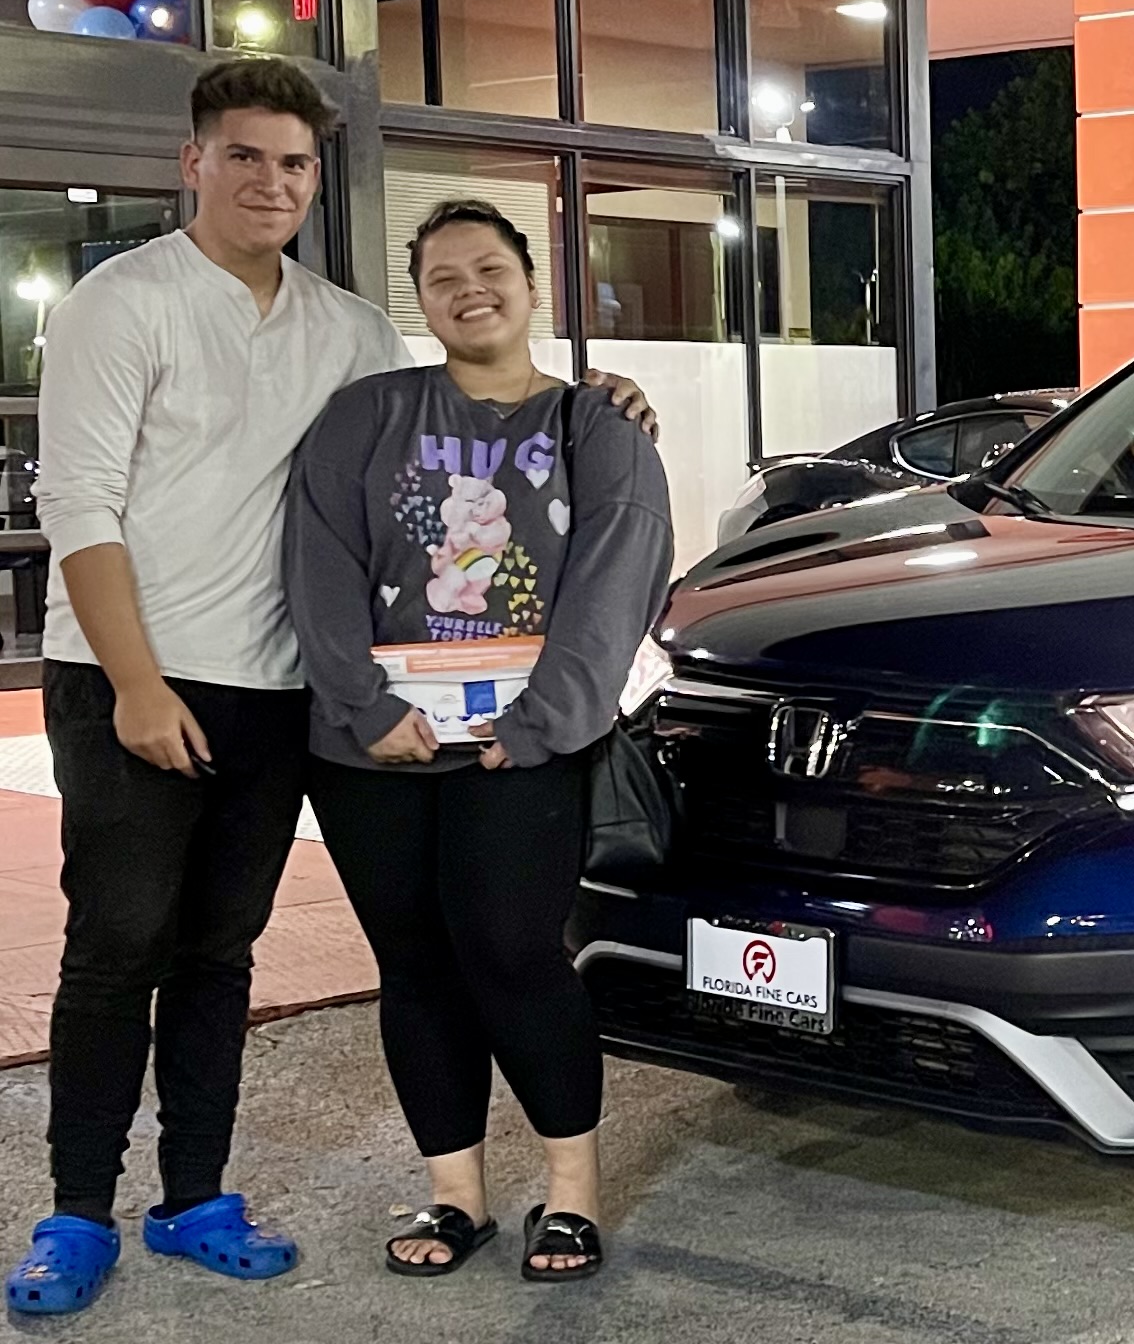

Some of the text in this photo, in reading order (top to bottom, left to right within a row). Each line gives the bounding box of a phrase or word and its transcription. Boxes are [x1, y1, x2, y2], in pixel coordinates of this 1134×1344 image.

[420, 432, 555, 480] HUG
[425, 614, 503, 635] YOURSELF
[702, 975, 818, 1009] FLORIDA FINE CARS
[748, 1002, 785, 1025] Fine
[789, 1009, 825, 1033] Cars
